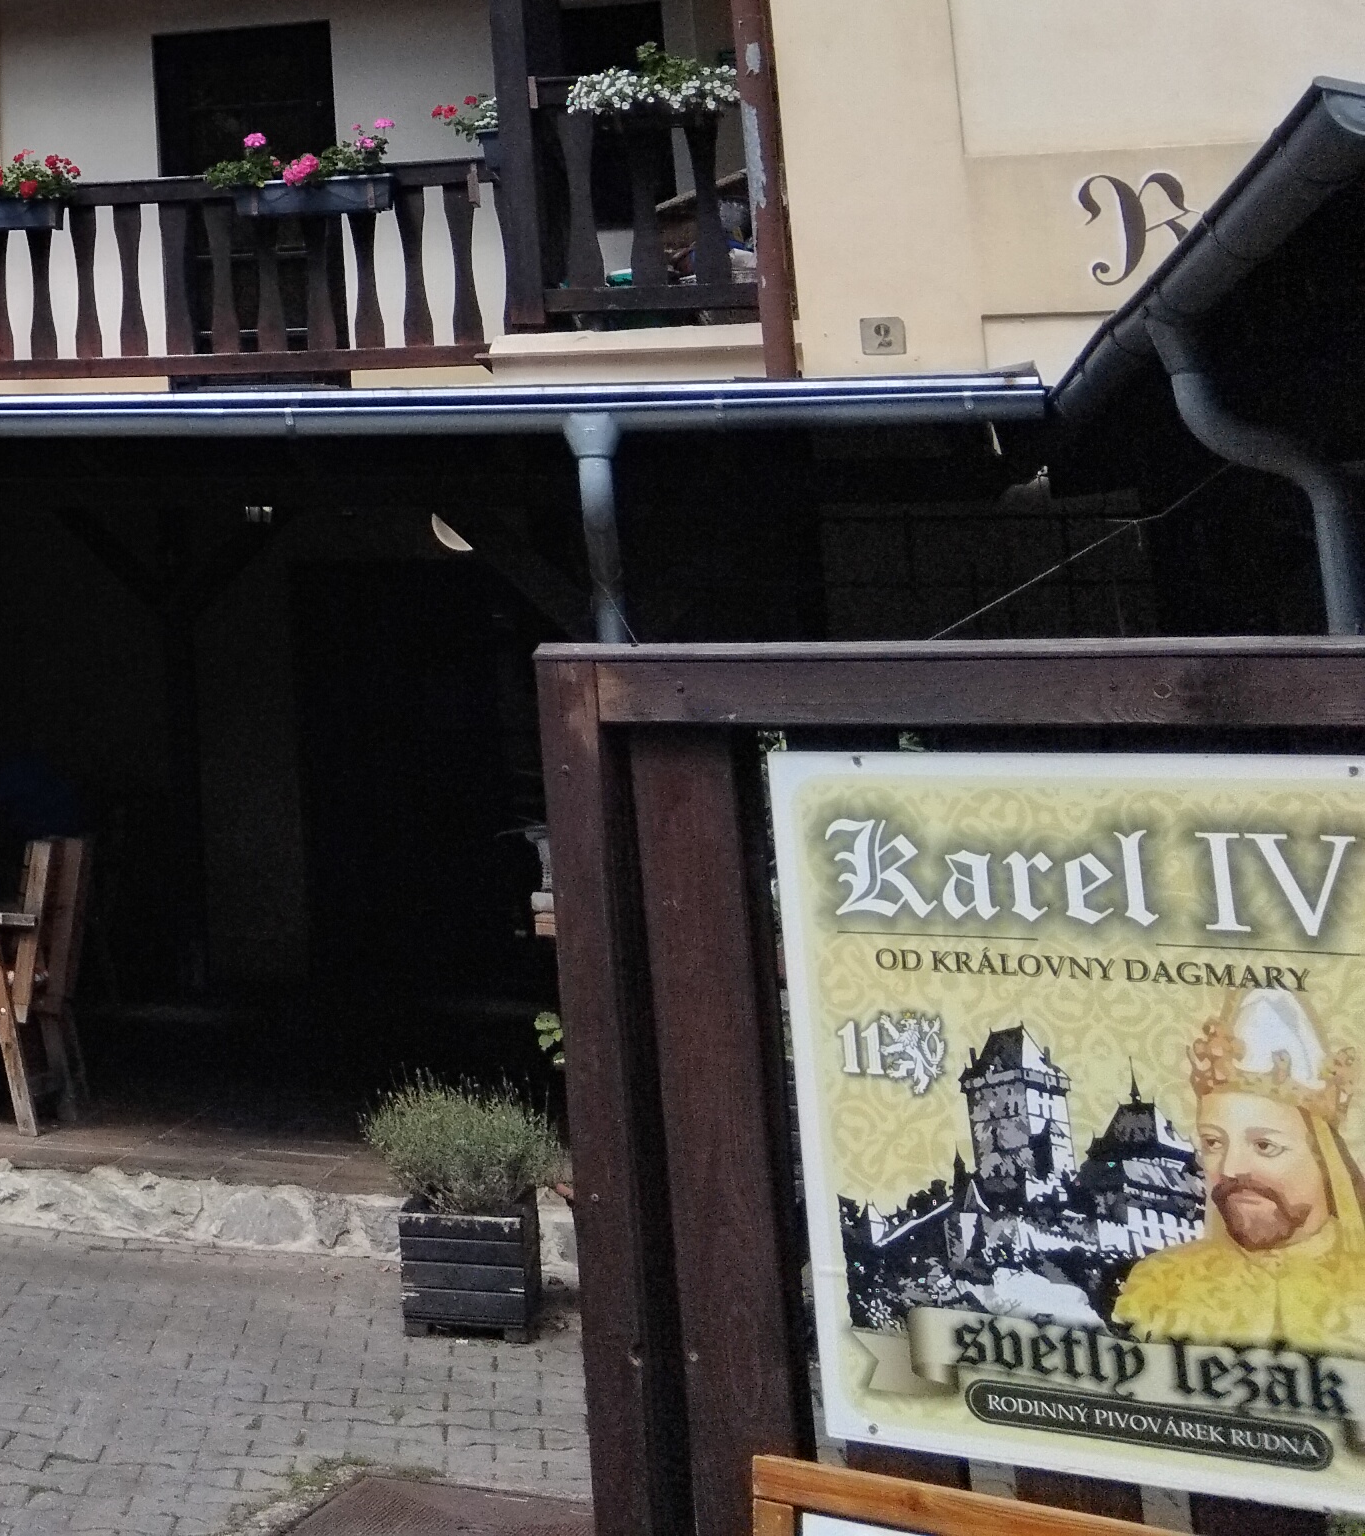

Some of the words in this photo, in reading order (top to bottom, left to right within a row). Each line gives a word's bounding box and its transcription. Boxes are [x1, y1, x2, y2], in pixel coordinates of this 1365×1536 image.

[874, 323, 893, 350] 2
[825, 818, 1160, 927] Karel
[1194, 830, 1357, 939] IV
[875, 947, 922, 972] OD
[931, 946, 1115, 982] KRÁLOVNY
[1124, 957, 1310, 993] DAGMARY
[955, 1313, 1152, 1398] světlý
[1170, 1334, 1350, 1416] ležák
[987, 1393, 1088, 1423] RODINNÝ
[1094, 1409, 1227, 1445] PIVOVÁREK
[1231, 1428, 1320, 1458] RUDNÁ
